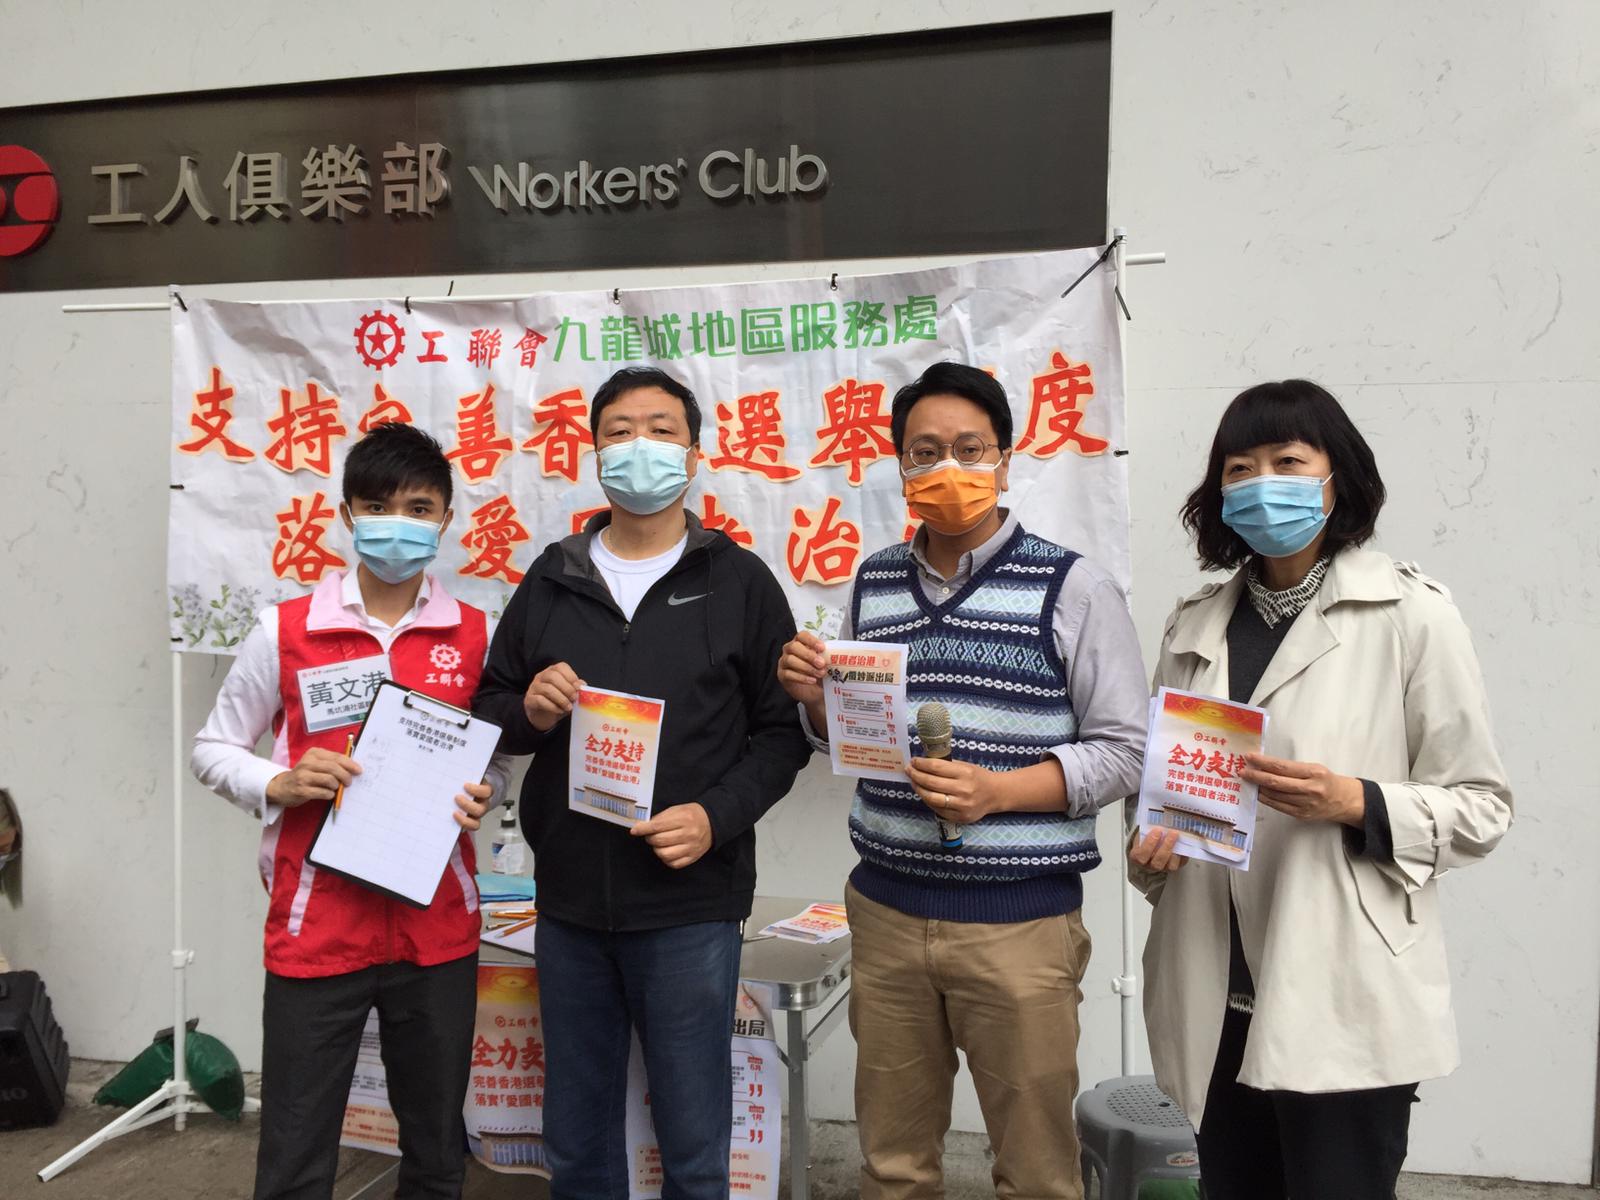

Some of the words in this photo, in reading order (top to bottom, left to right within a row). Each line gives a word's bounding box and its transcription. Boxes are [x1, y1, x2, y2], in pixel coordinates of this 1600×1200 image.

[88, 142, 449, 225] 工人俱樂部
[699, 144, 827, 199] Club
[417, 327, 548, 369] 工聯會
[553, 295, 938, 362] 九龍城地區服務處
[585, 733, 646, 762] 全力支持
[1168, 743, 1247, 778] 全力支持
